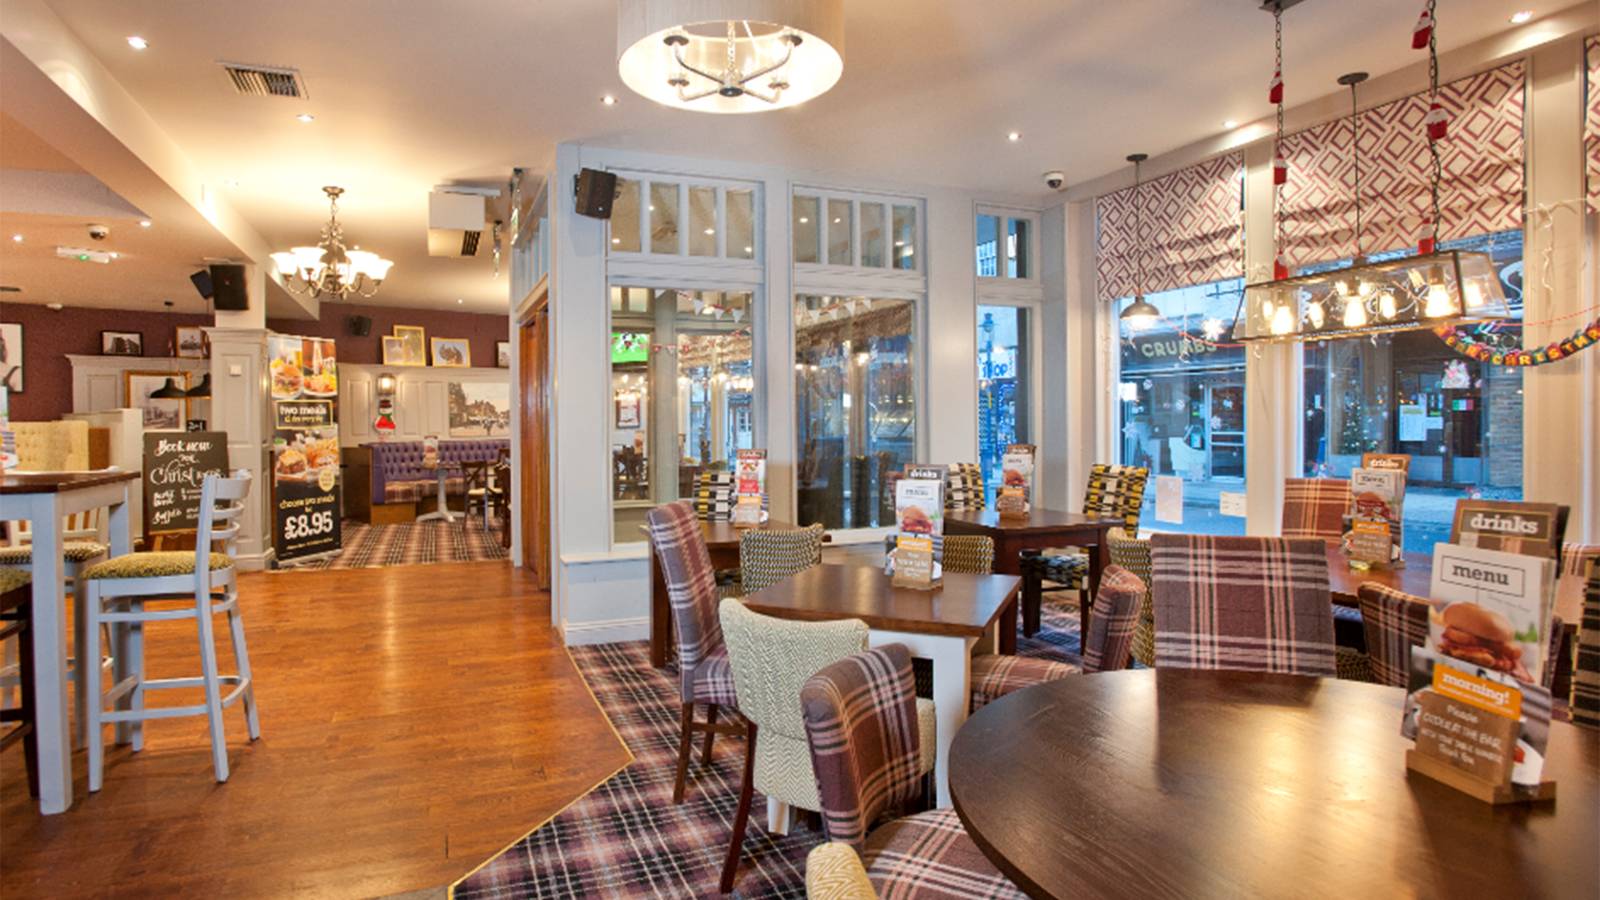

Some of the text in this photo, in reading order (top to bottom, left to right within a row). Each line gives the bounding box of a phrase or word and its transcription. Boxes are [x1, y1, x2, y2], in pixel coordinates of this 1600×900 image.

[1141, 339, 1217, 358] CRUMBS
[284, 510, 334, 540] £8.95
[1470, 513, 1539, 534] drinks
[1452, 564, 1510, 586] menu
[1442, 673, 1510, 705] morning!
